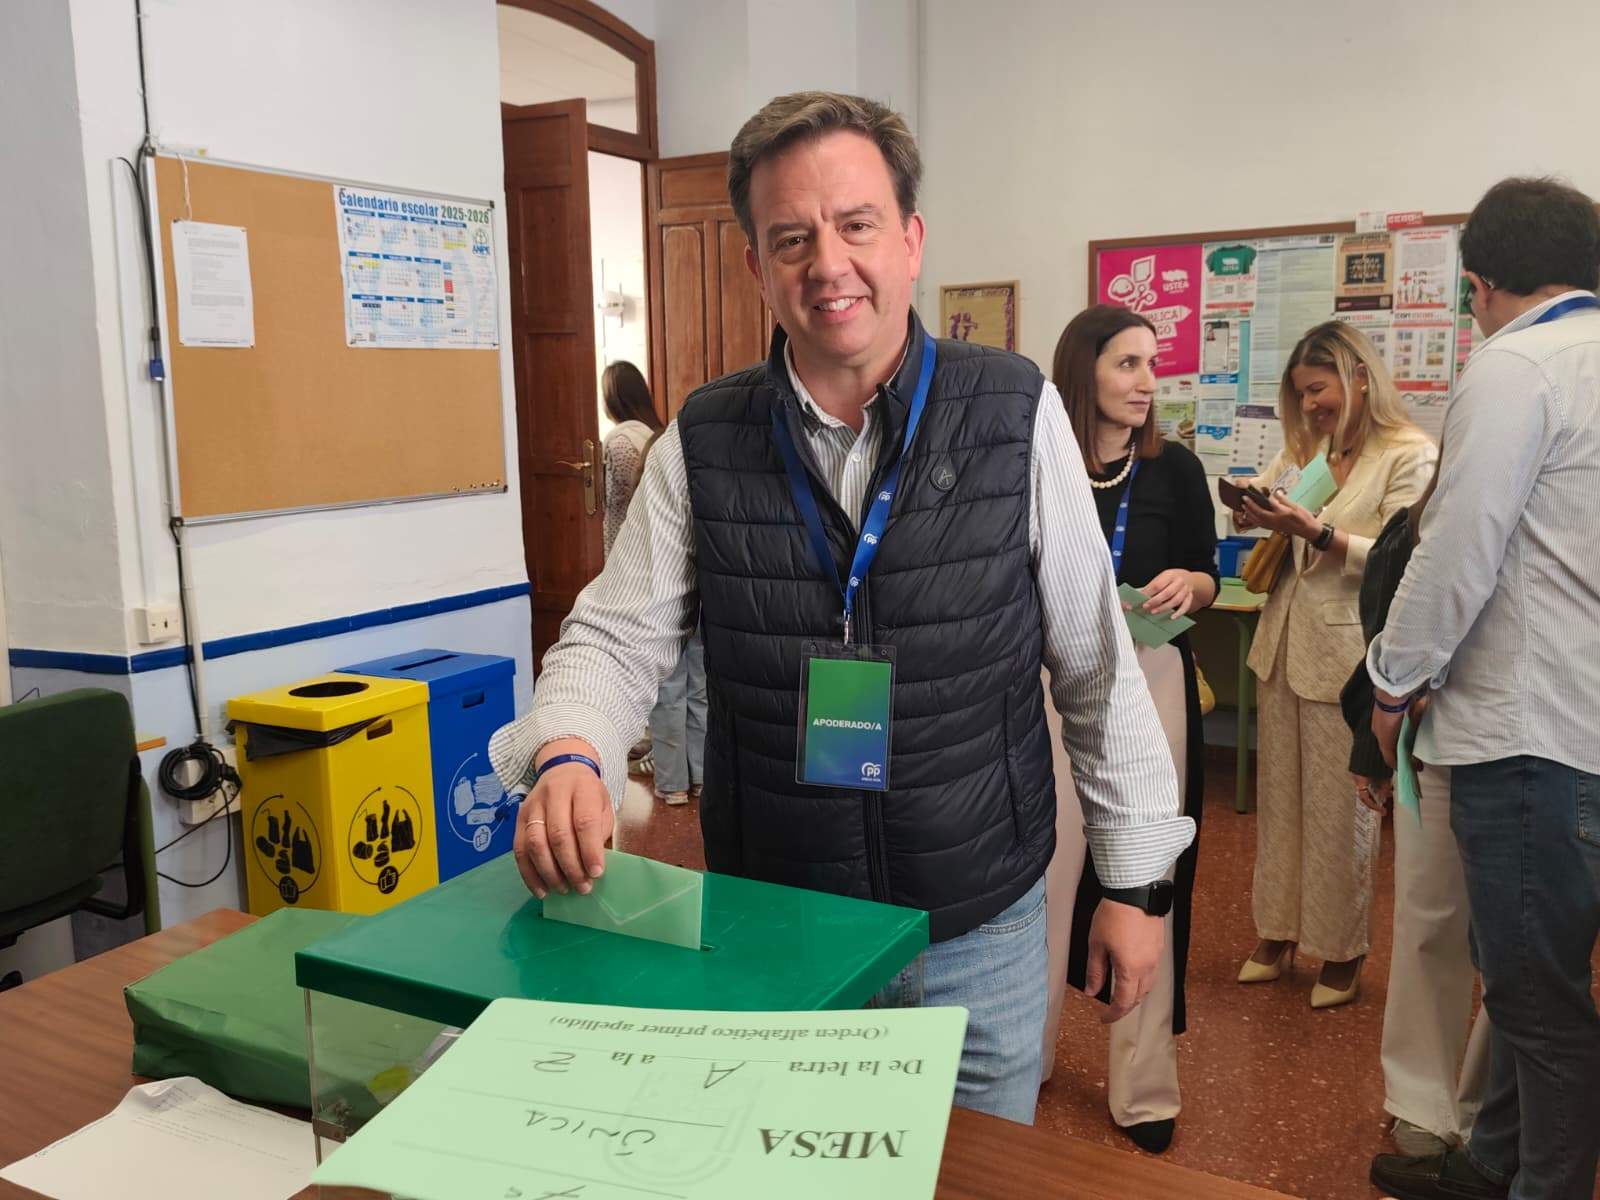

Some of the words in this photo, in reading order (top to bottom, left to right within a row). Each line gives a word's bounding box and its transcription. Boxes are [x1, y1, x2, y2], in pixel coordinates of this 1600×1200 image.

[338, 190, 399, 213] Calendario
[401, 201, 439, 217] escolar
[441, 205, 489, 225] 2025-2026
[812, 718, 882, 731] APODERADO/A
[550, 1016, 635, 1032] apellido)
[638, 1023, 708, 1038] primer
[712, 1026, 809, 1041] alfabético
[816, 1025, 889, 1040] (Orden
[611, 1051, 634, 1066] la
[640, 1054, 656, 1064] a
[704, 1060, 747, 1090] A
[789, 1060, 848, 1076] letra
[858, 1060, 880, 1076] la
[889, 1059, 924, 1075] De
[758, 1128, 912, 1159] MESA
